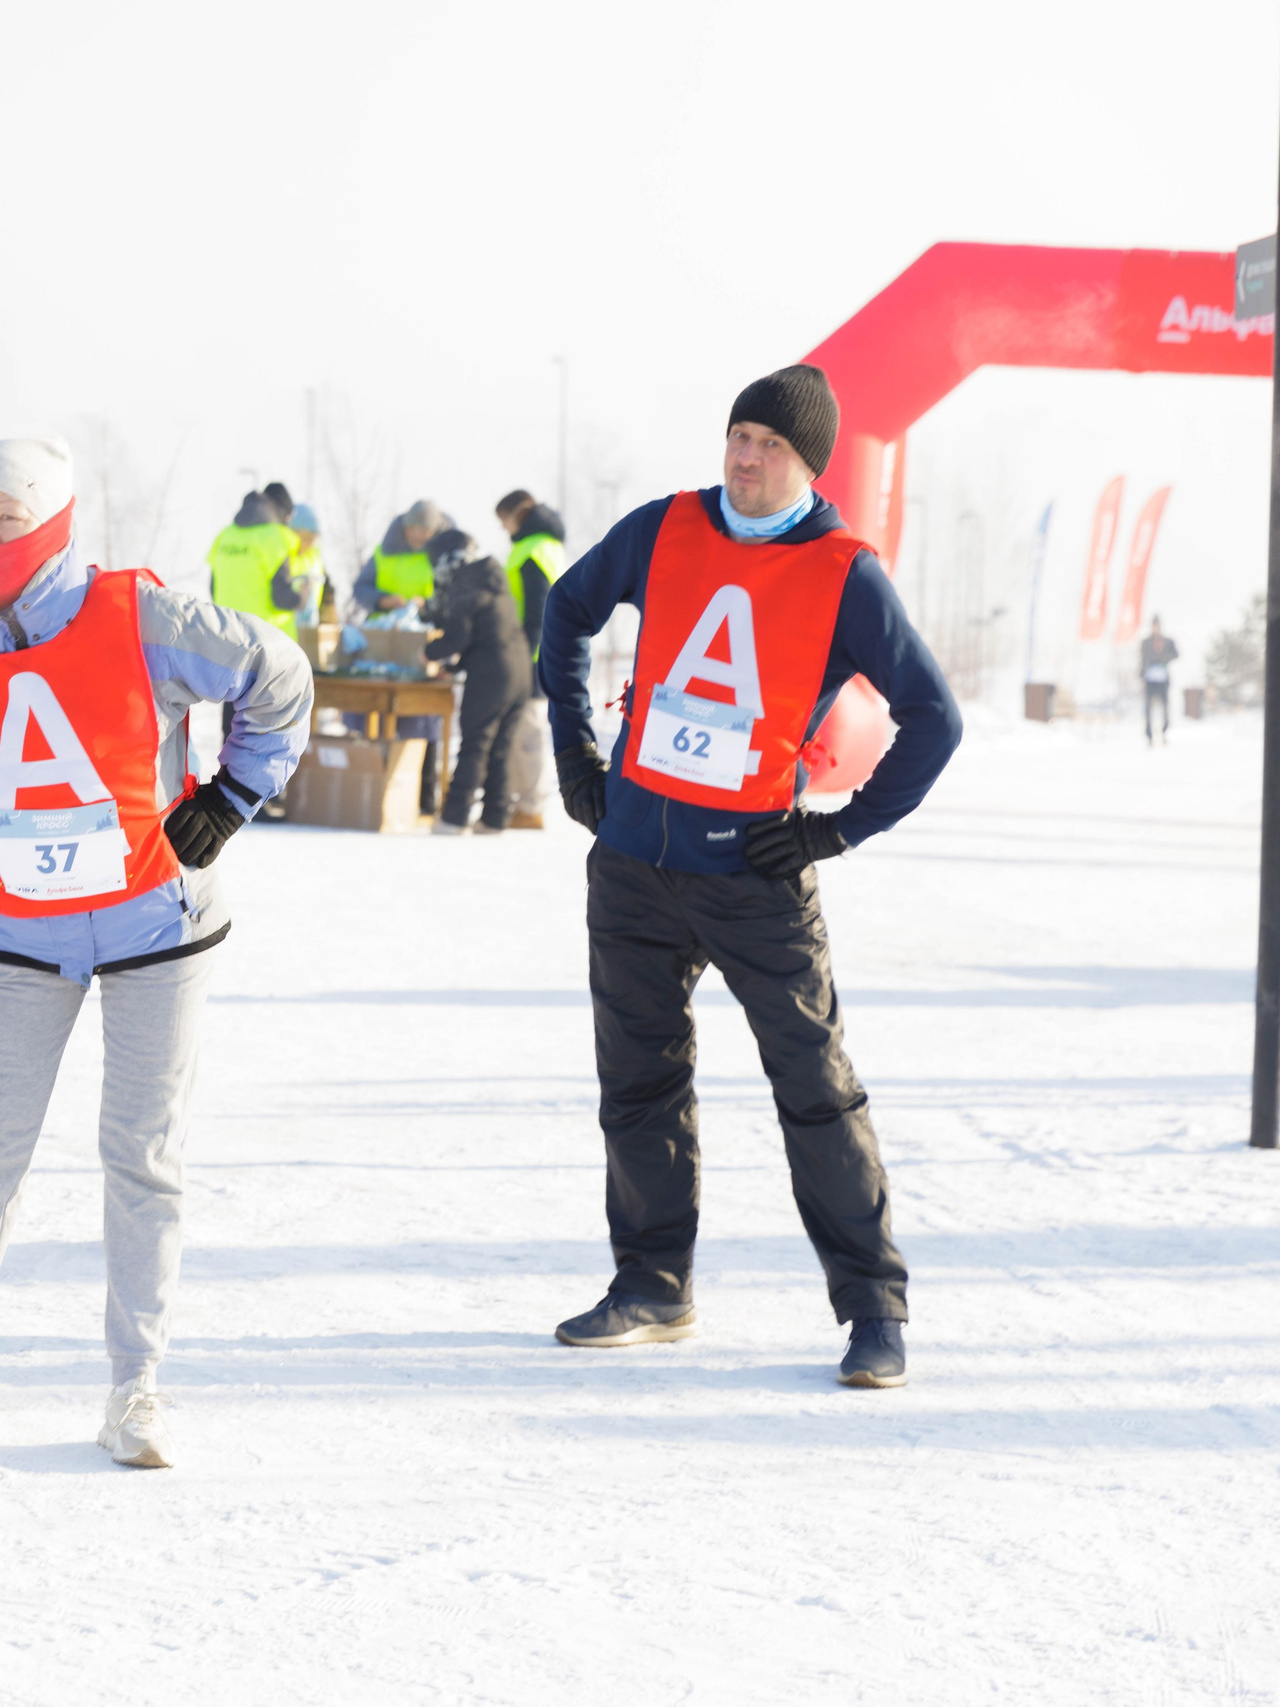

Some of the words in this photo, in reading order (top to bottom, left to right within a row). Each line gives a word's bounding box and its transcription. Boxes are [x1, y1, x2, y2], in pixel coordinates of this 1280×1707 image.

[662, 584, 765, 719] А
[672, 726, 711, 759] 62
[35, 842, 79, 874] 37
